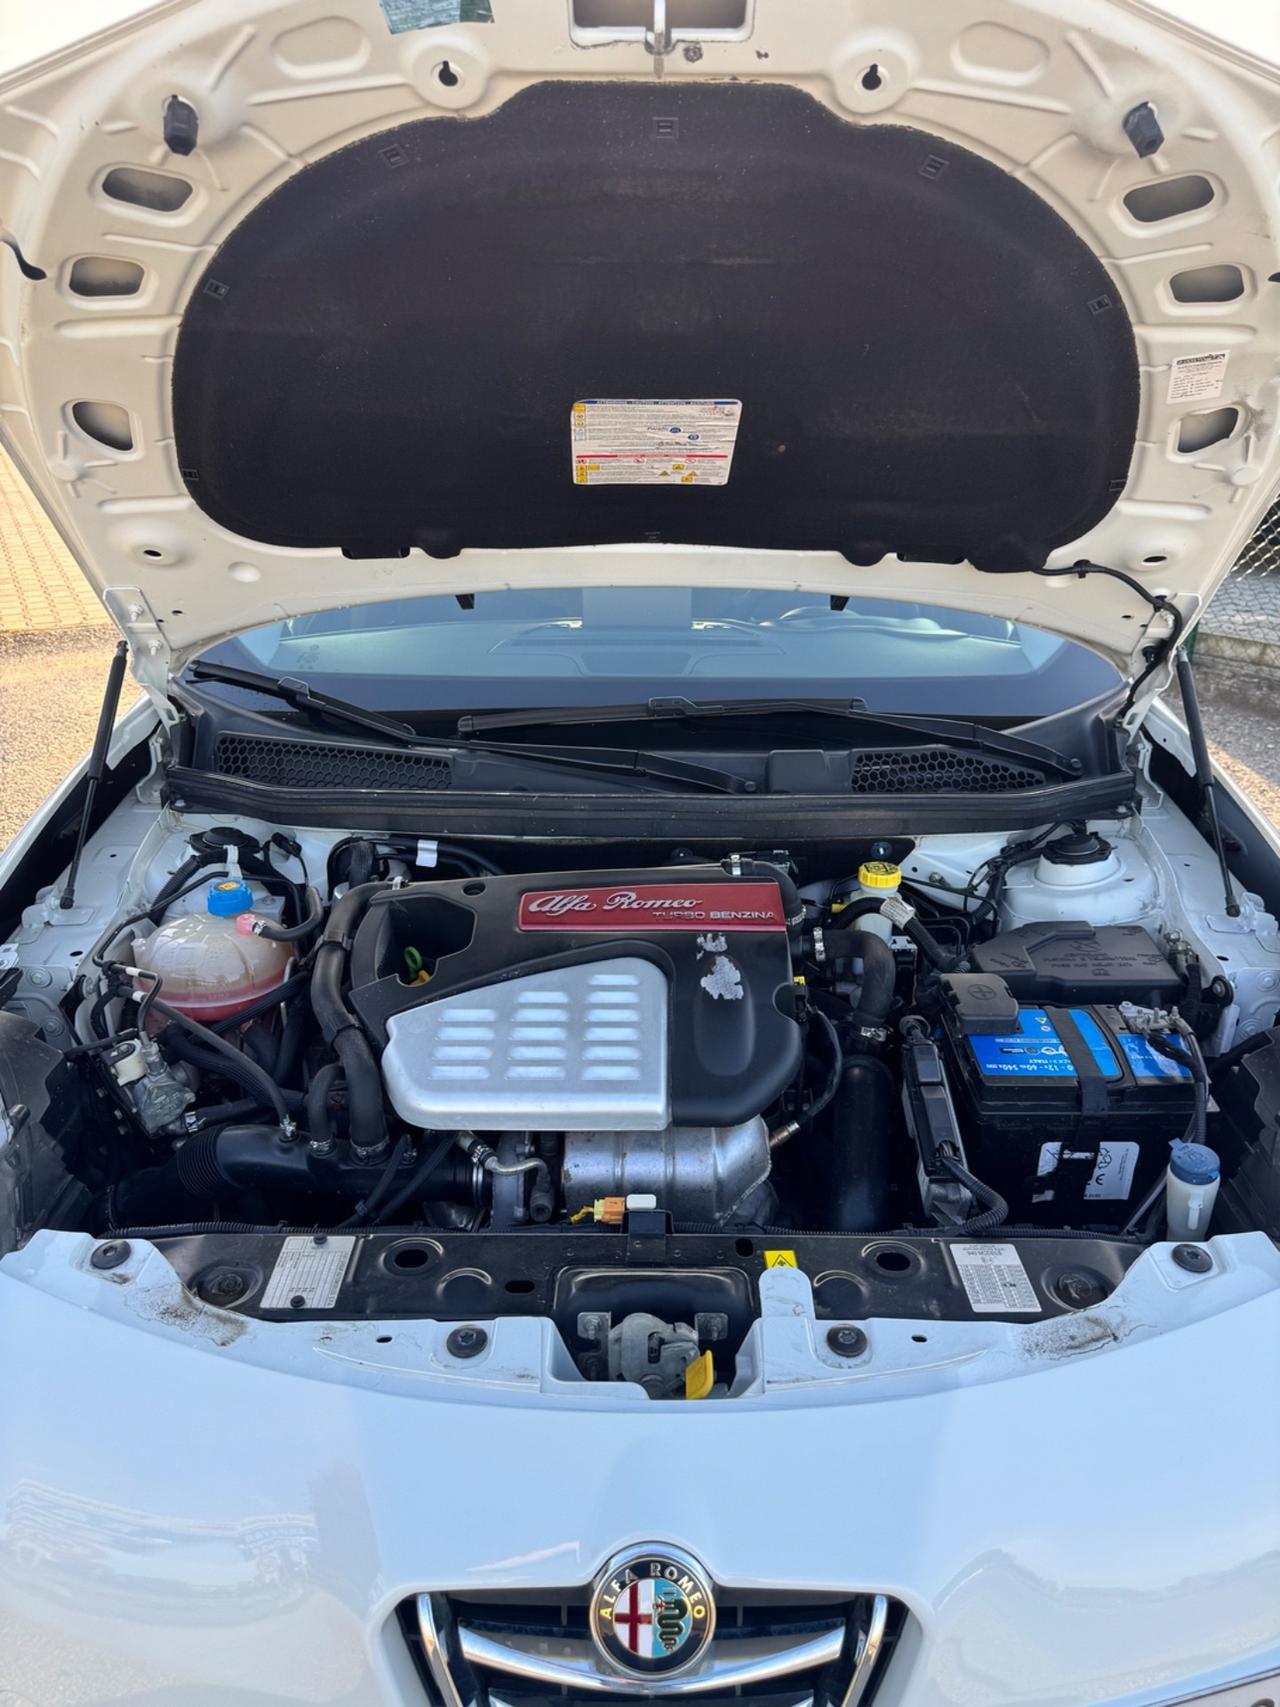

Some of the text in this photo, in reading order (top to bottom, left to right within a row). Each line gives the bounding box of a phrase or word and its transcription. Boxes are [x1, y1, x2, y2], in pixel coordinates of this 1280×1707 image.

[528, 891, 703, 916] Alfa Romeo
[652, 910, 777, 920] TURBO BENZINA
[600, 1562, 706, 1620] ALFA ROMEO
